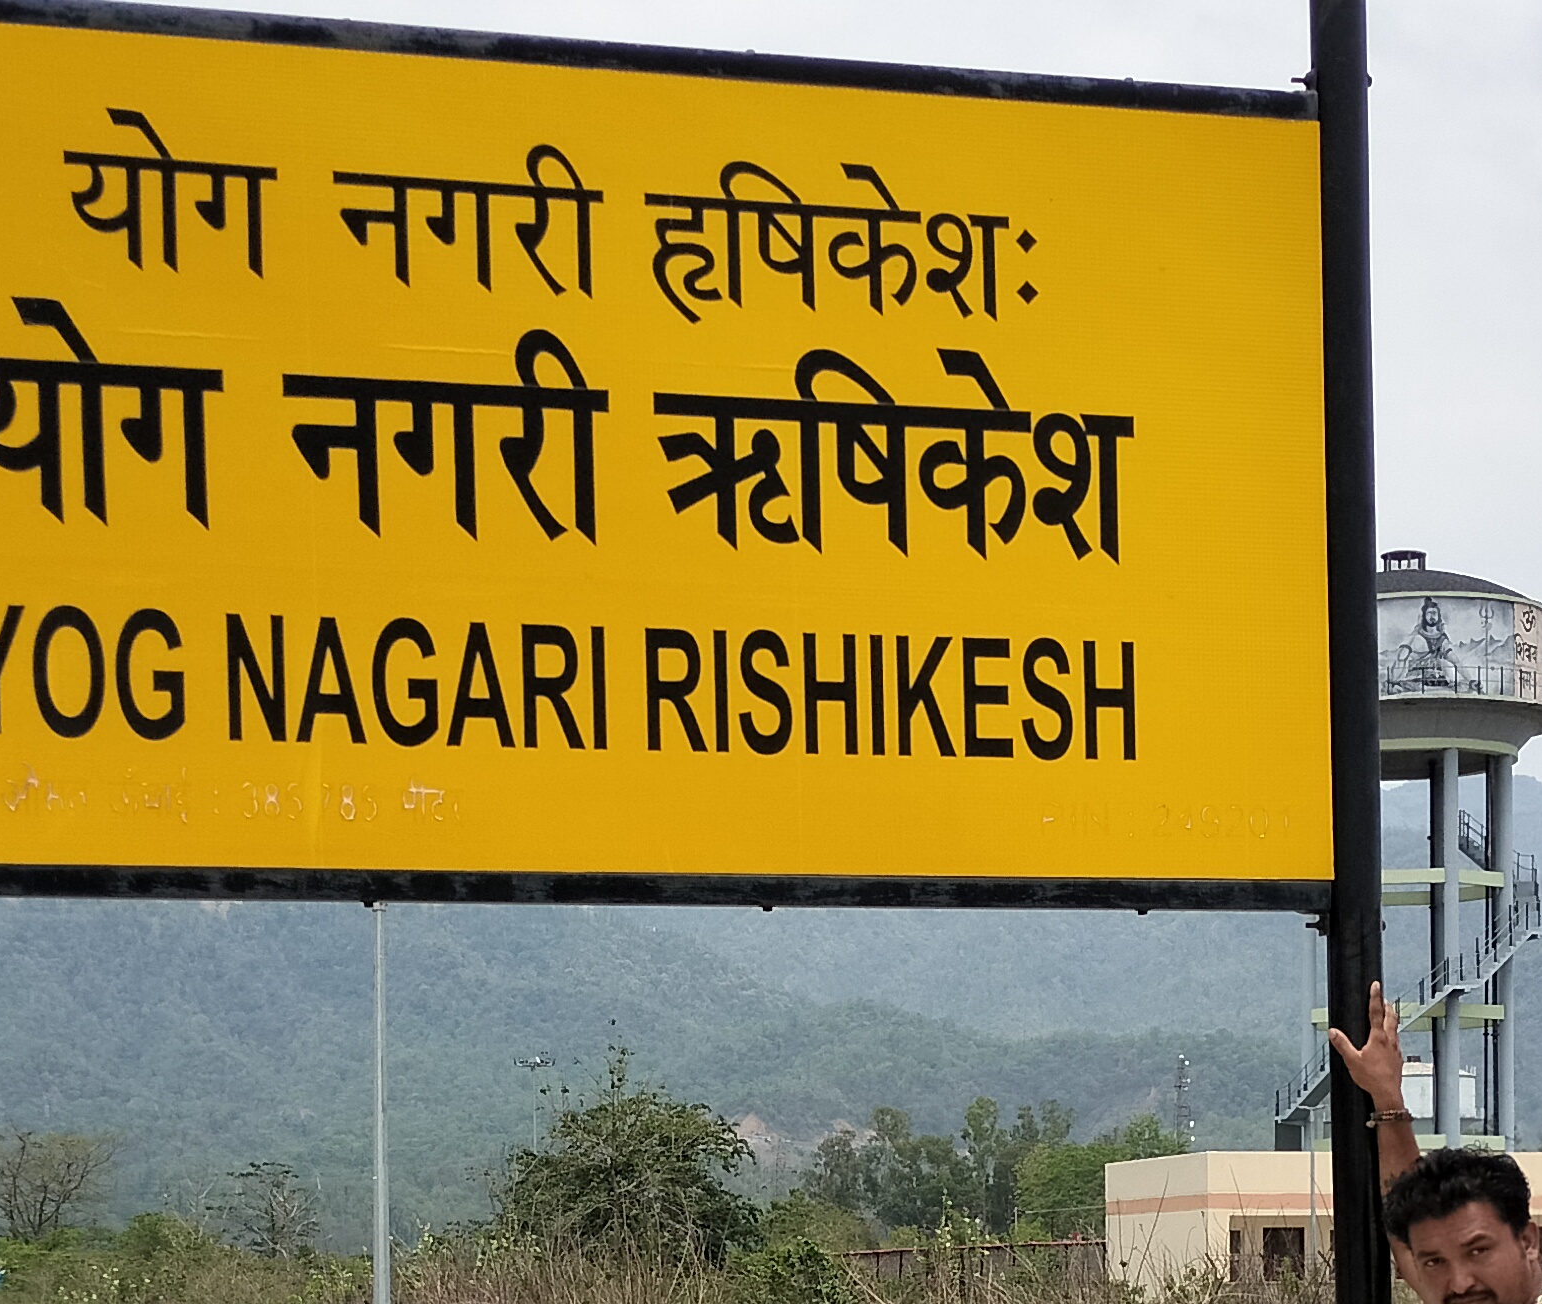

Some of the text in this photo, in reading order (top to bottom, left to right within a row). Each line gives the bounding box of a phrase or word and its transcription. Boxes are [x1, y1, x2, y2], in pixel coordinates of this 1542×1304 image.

[64, 108, 1039, 323] योग नगरी हृषिकेशः
[281, 328, 610, 546] नगरी
[652, 347, 1136, 565] ऋषिकेश
[225, 613, 609, 750] NAGARI
[644, 627, 1138, 761] RISHIKESH
